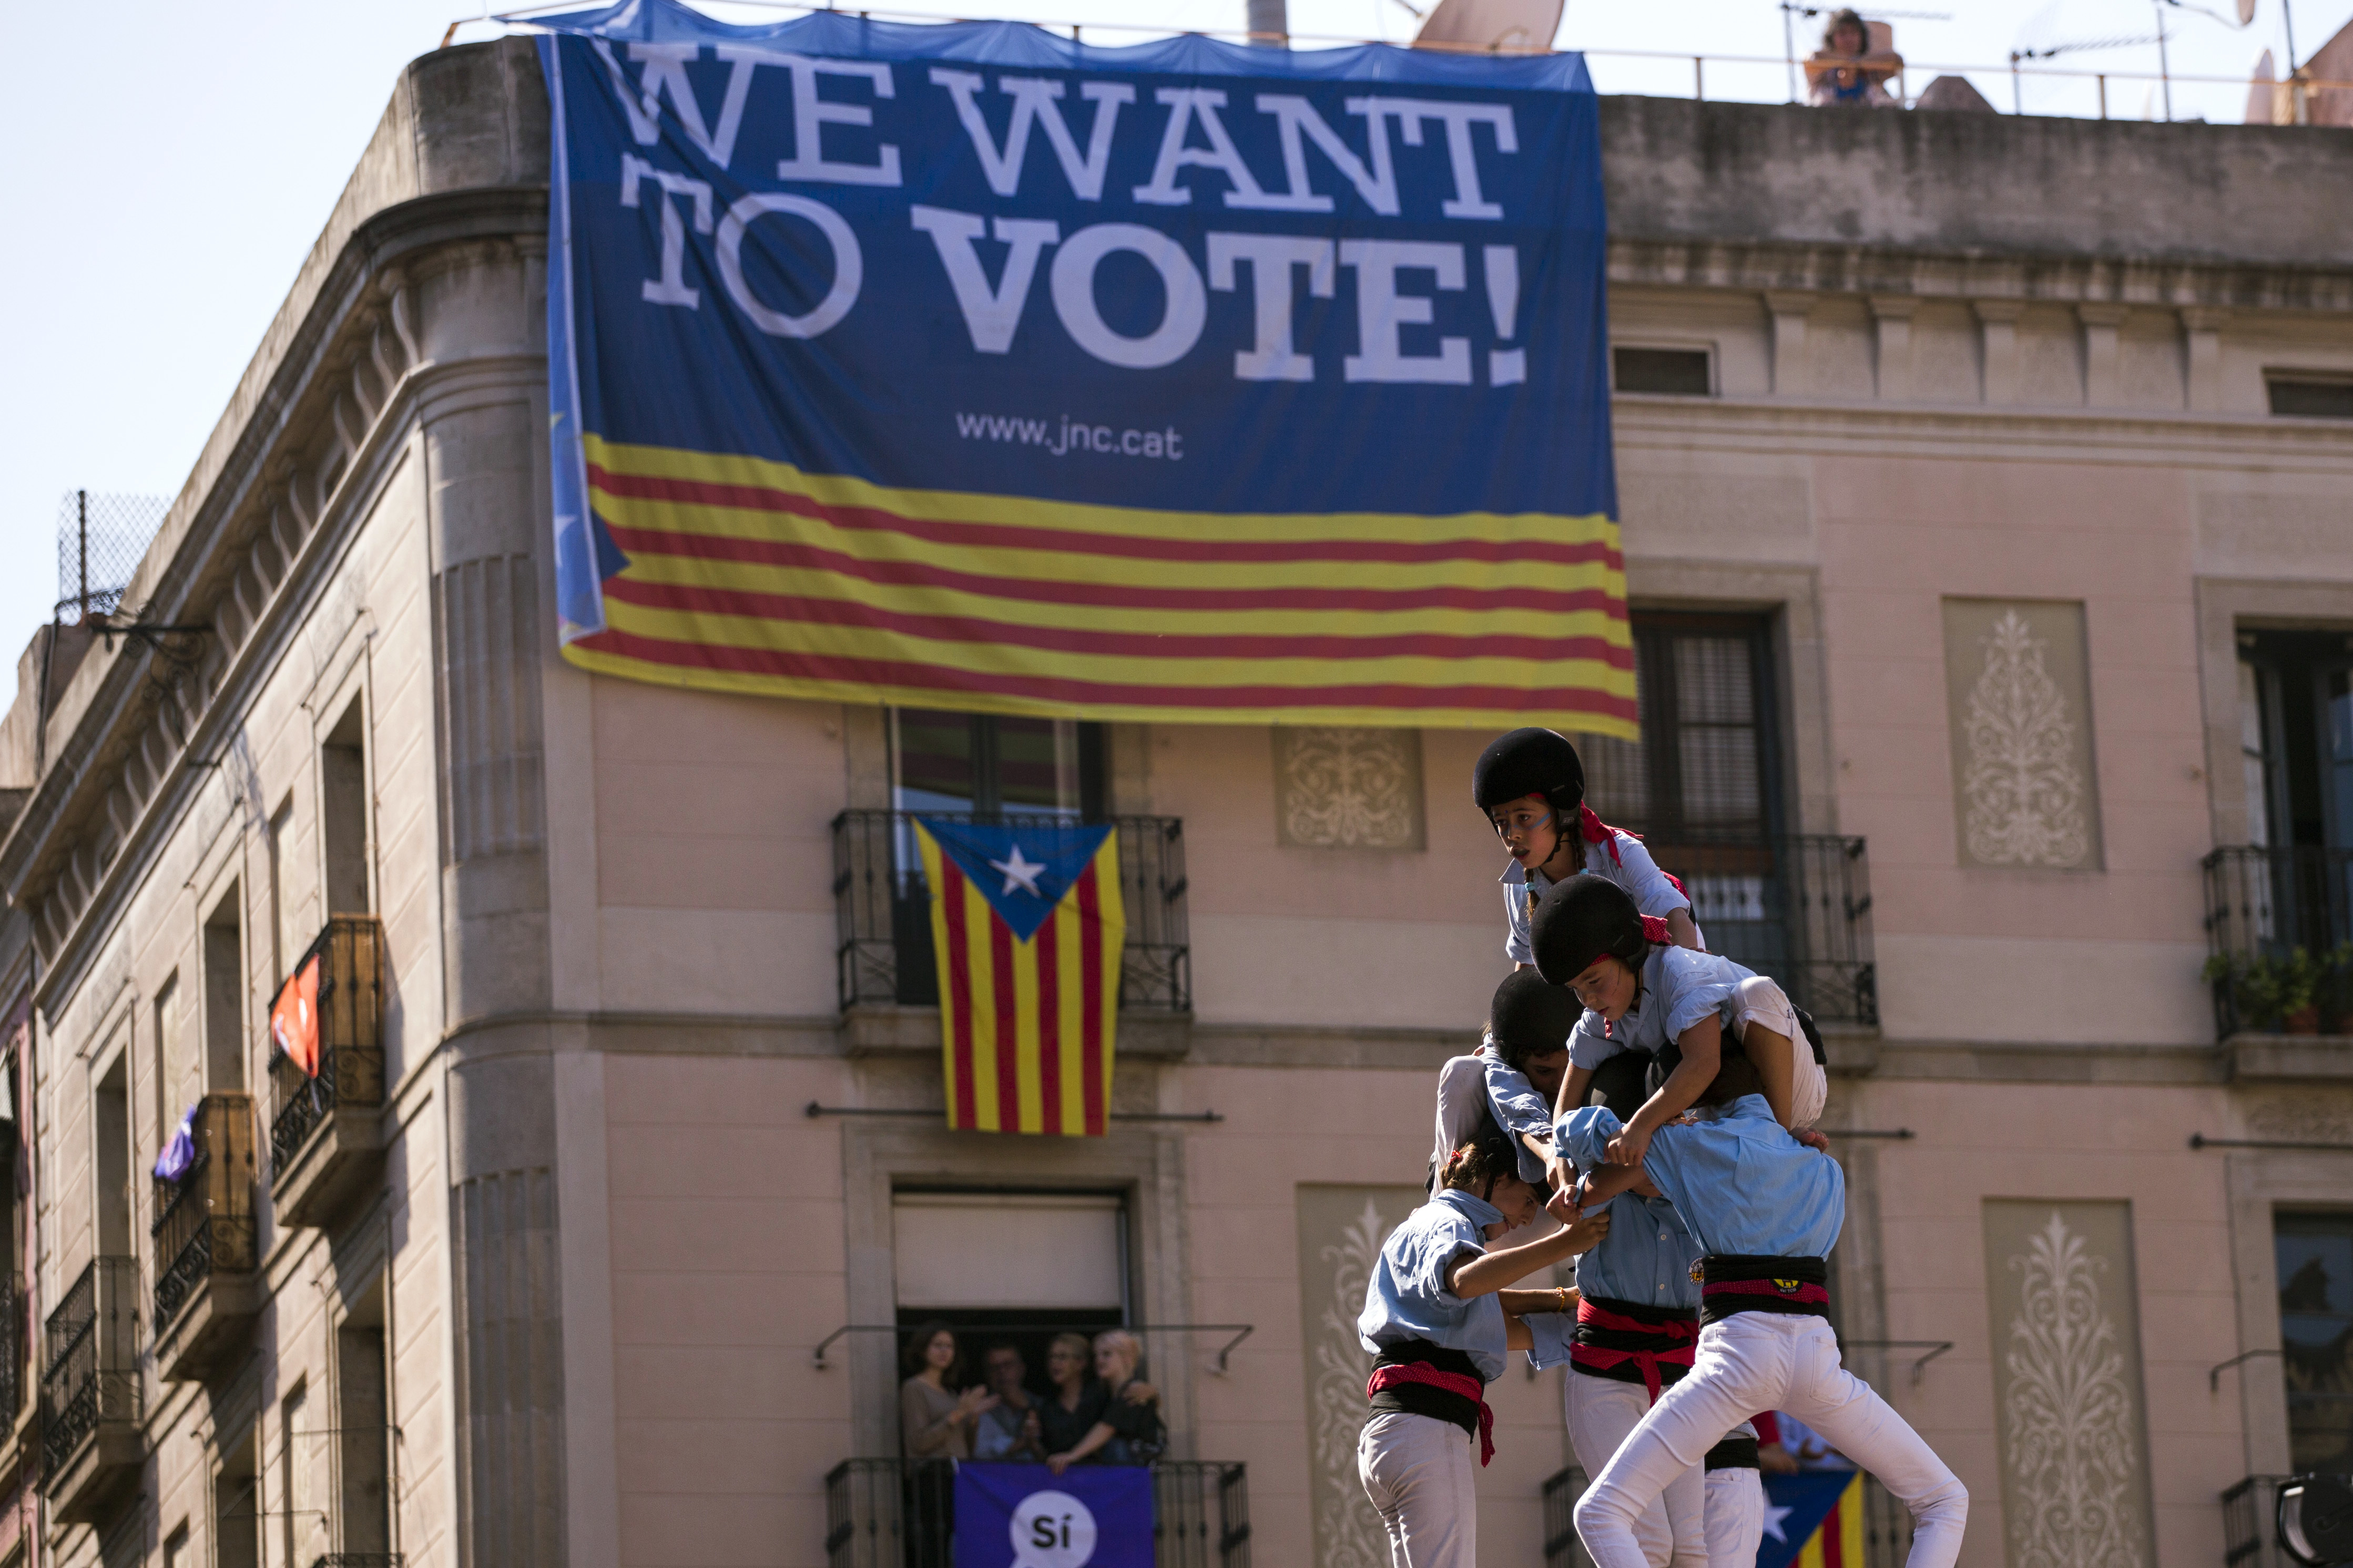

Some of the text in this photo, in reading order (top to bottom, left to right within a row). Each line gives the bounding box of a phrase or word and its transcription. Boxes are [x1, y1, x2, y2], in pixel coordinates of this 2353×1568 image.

[590, 36, 1519, 220] WE WANT
[621, 151, 1526, 387] TO VOTE!
[955, 412, 1184, 460] www.jnc.cat
[1032, 1513, 1073, 1549] Sí
